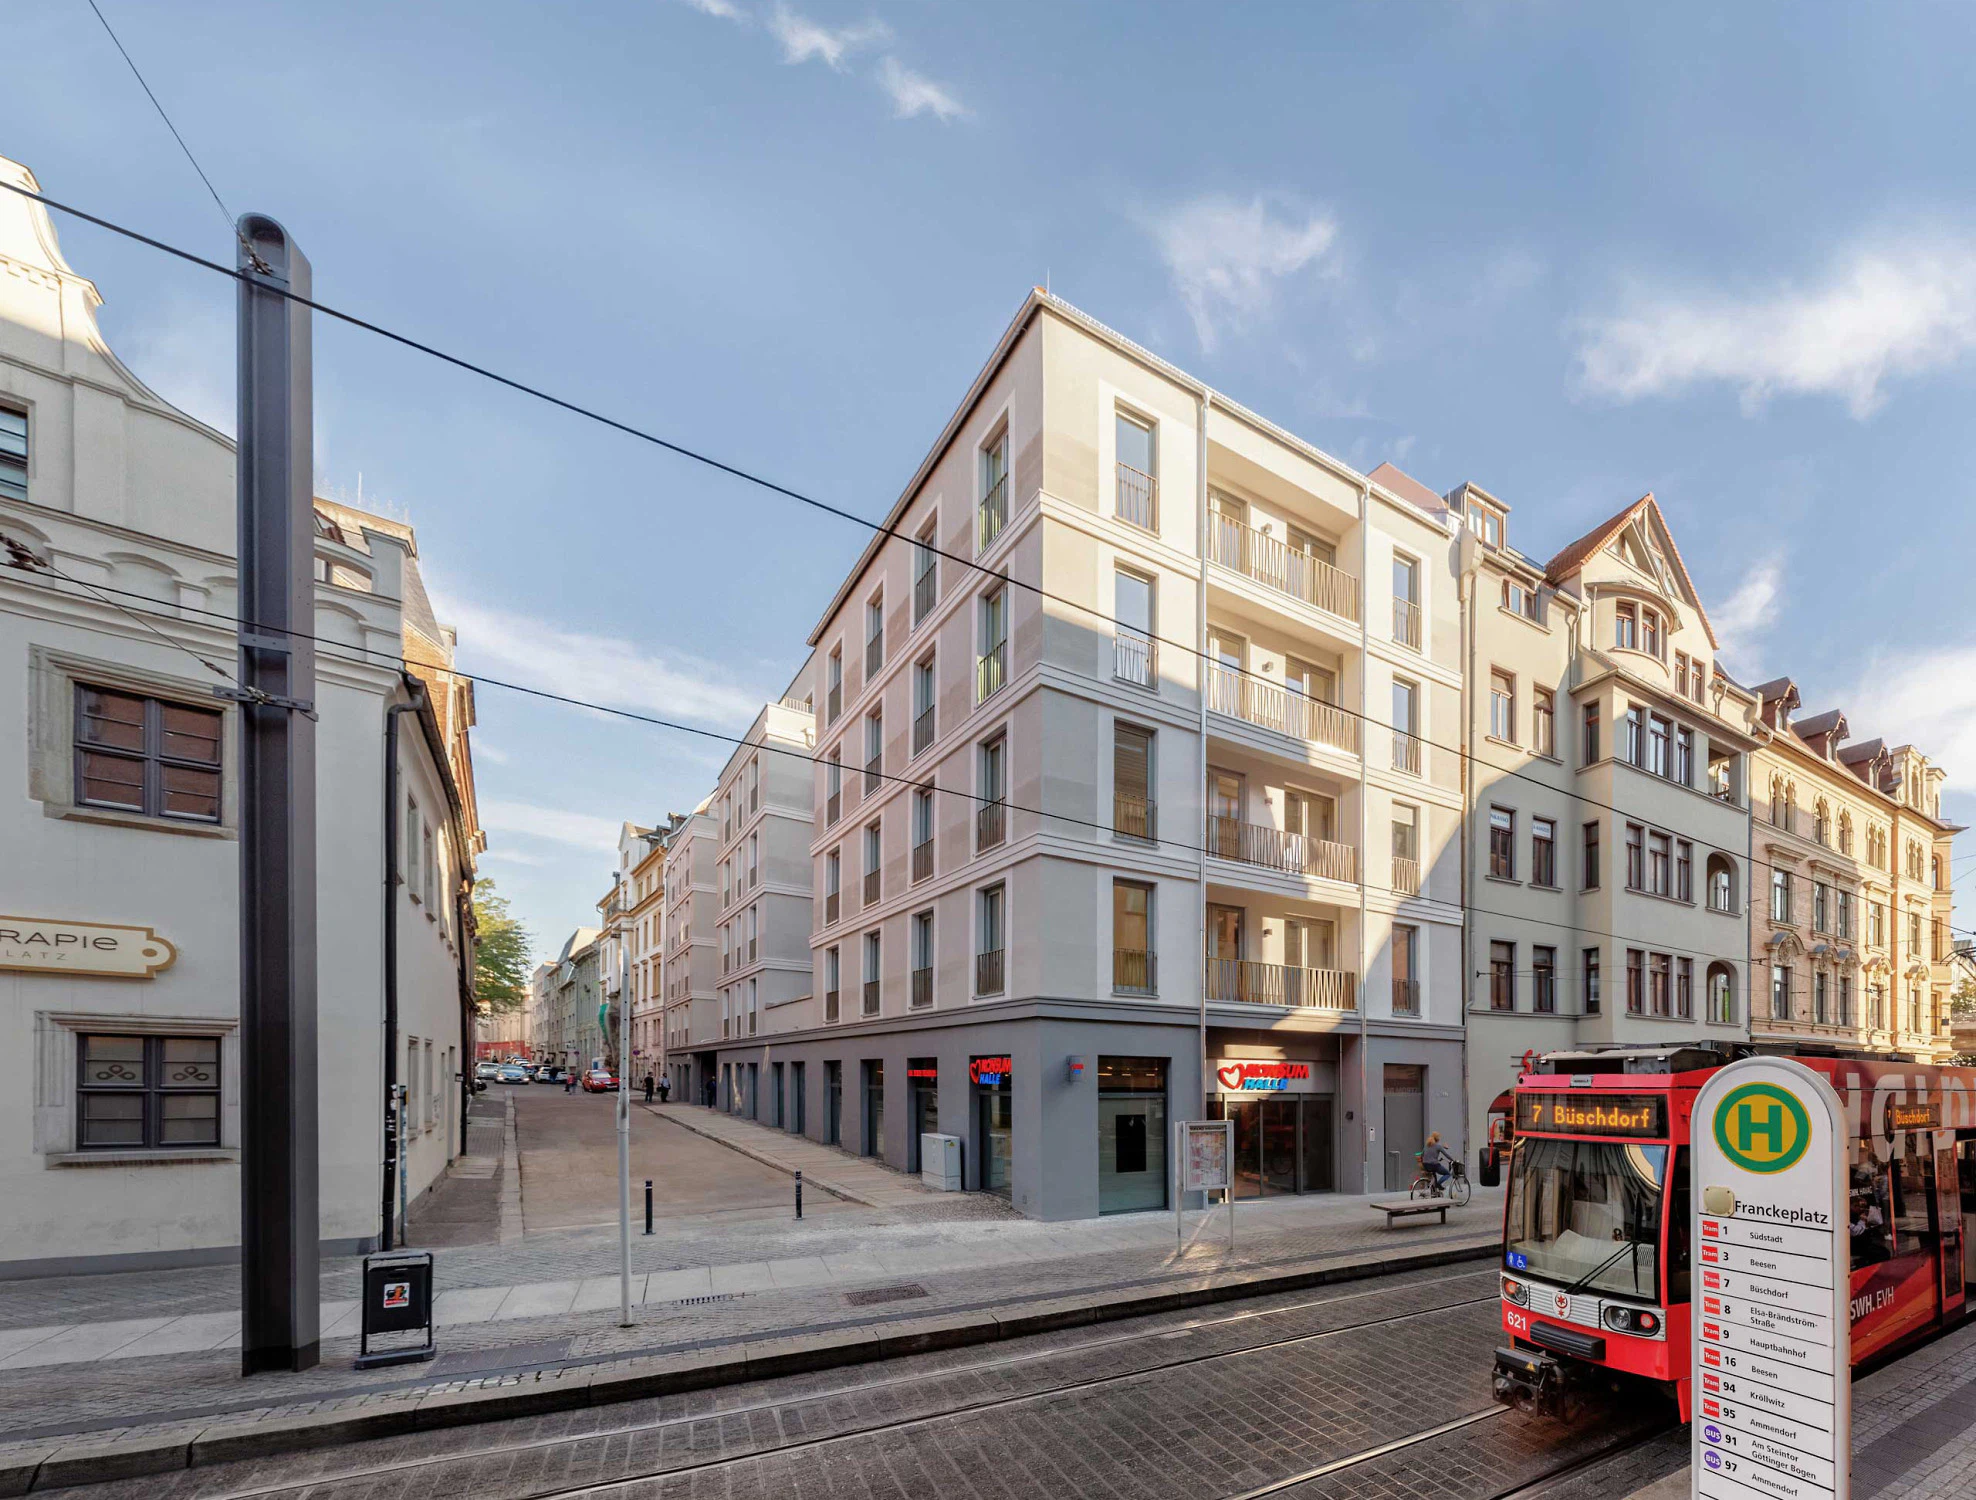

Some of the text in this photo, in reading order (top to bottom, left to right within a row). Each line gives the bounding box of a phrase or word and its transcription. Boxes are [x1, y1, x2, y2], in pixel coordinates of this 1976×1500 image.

[980, 1073, 1000, 1084] HALLE
[1243, 1063, 1309, 1078] KONSUM
[1243, 1078, 1289, 1090] HALLE
[1532, 1105, 1650, 1128] 7 Büschdorf
[1738, 1104, 1782, 1153] H
[1895, 1108, 1930, 1125] Büschdorf
[1735, 1200, 1828, 1225] Franckeplatz
[1703, 1224, 1783, 1243] Tram 1 Südstadt
[1702, 1249, 1777, 1270] Tram 3 Beesen
[1704, 1275, 1788, 1299] Tram 7 Büschdorf
[1704, 1300, 1818, 1328] Tram 8 Elsa-Brändström-
[1850, 1286, 1895, 1320] SWH. EVH
[1507, 1311, 1527, 1331] 621
[1750, 1317, 1776, 1329] Straße
[1704, 1326, 1807, 1359] Tram 9 Hauptbahnhof
[1704, 1352, 1778, 1379] Tram 16 Beesen
[1704, 1377, 1785, 1408] Tram 94 Kröllwitz
[1704, 1403, 1797, 1439] Tram 95 Ammendorf
[1705, 1429, 1799, 1462] BUS 91 Am Steintor
[1705, 1455, 1798, 1496] BUS 97 Ammendorf
[1752, 1450, 1817, 1480] Göttinger Bogen
